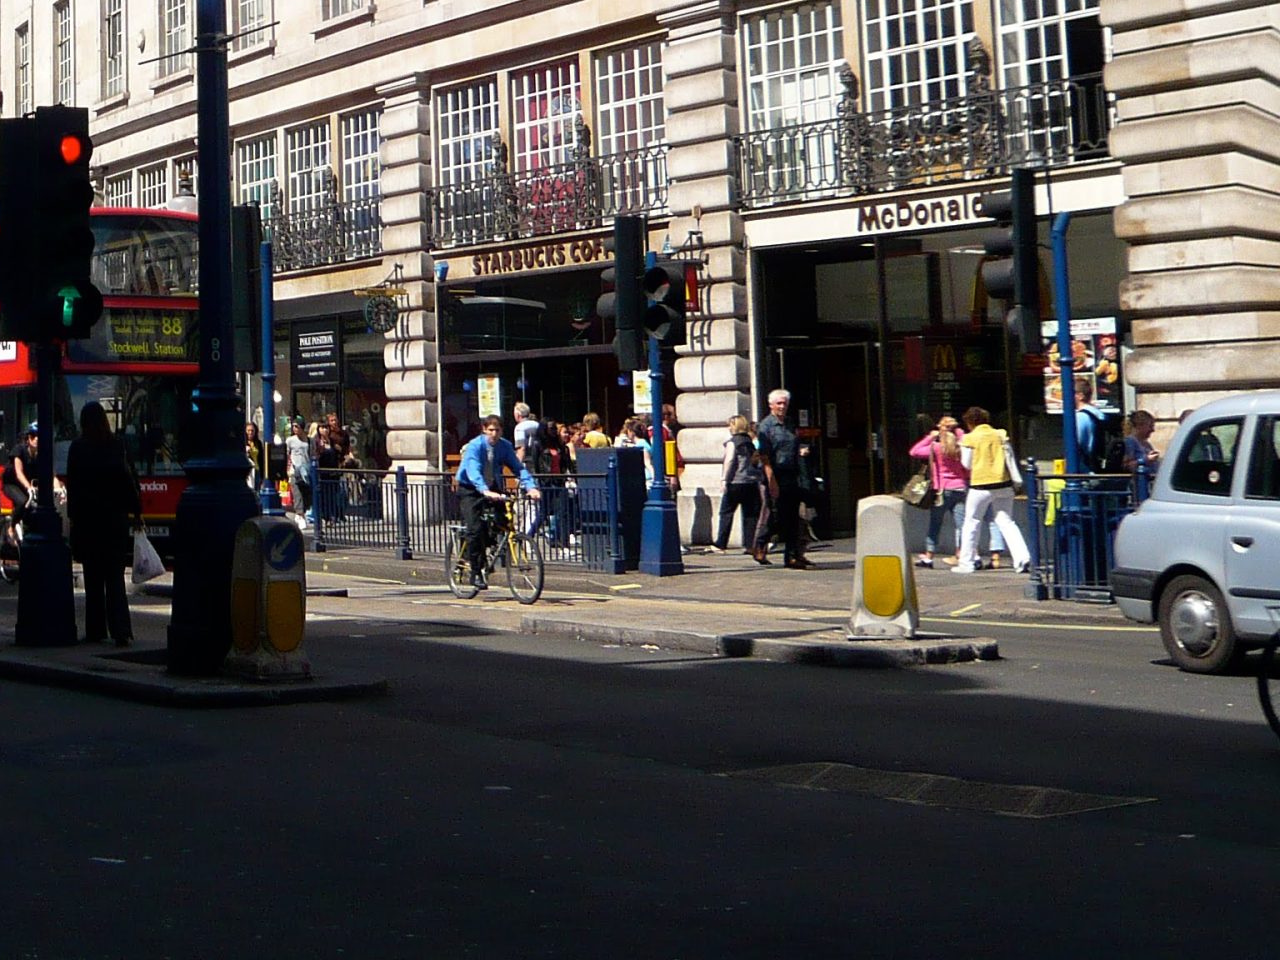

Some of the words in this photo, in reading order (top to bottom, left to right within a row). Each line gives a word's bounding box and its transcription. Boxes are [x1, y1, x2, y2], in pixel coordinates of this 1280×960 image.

[472, 243, 566, 276] STARBUCKS
[161, 315, 182, 335] 88
[107, 340, 149, 355] Stockwell
[154, 341, 185, 356] Station
[139, 480, 169, 492] ondon
